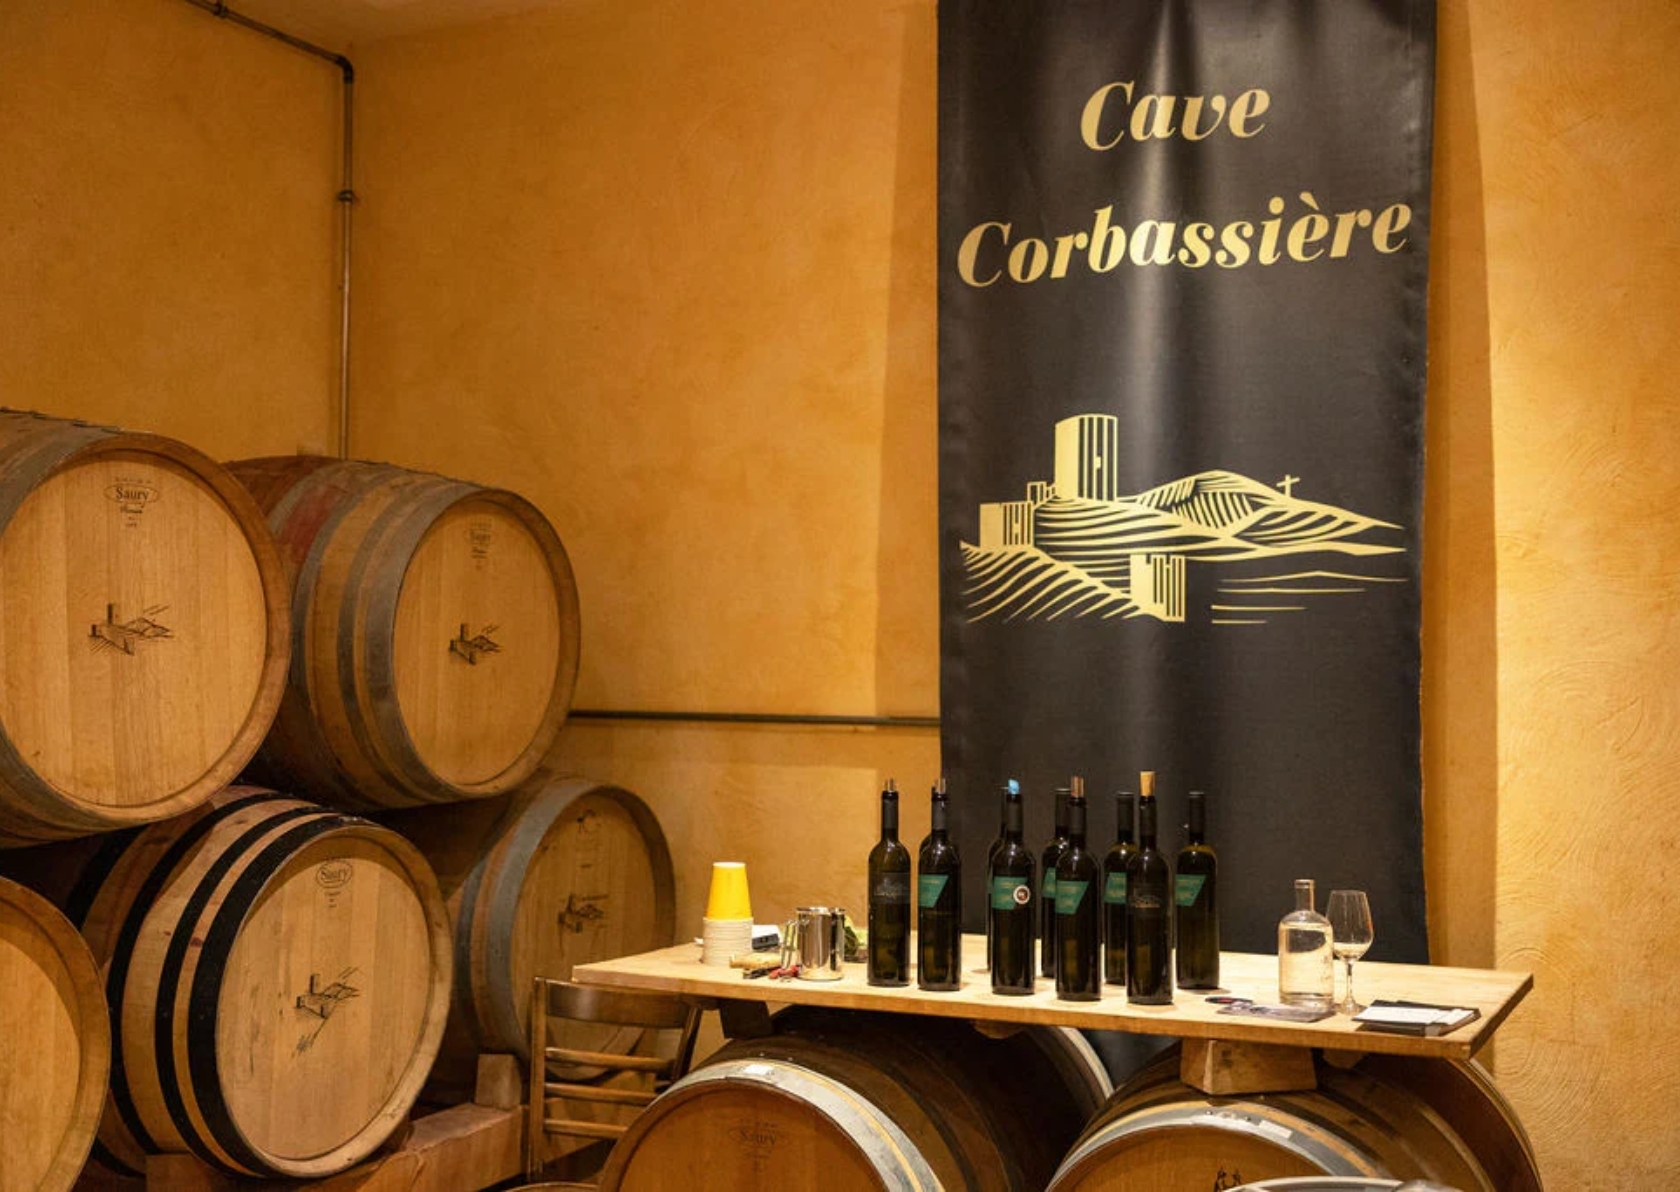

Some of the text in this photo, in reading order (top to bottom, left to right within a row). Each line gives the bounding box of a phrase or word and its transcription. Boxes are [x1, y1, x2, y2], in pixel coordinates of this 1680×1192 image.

[1080, 80, 1271, 151] Cave
[957, 191, 1413, 288] Corbassière
[115, 487, 149, 502] Saury
